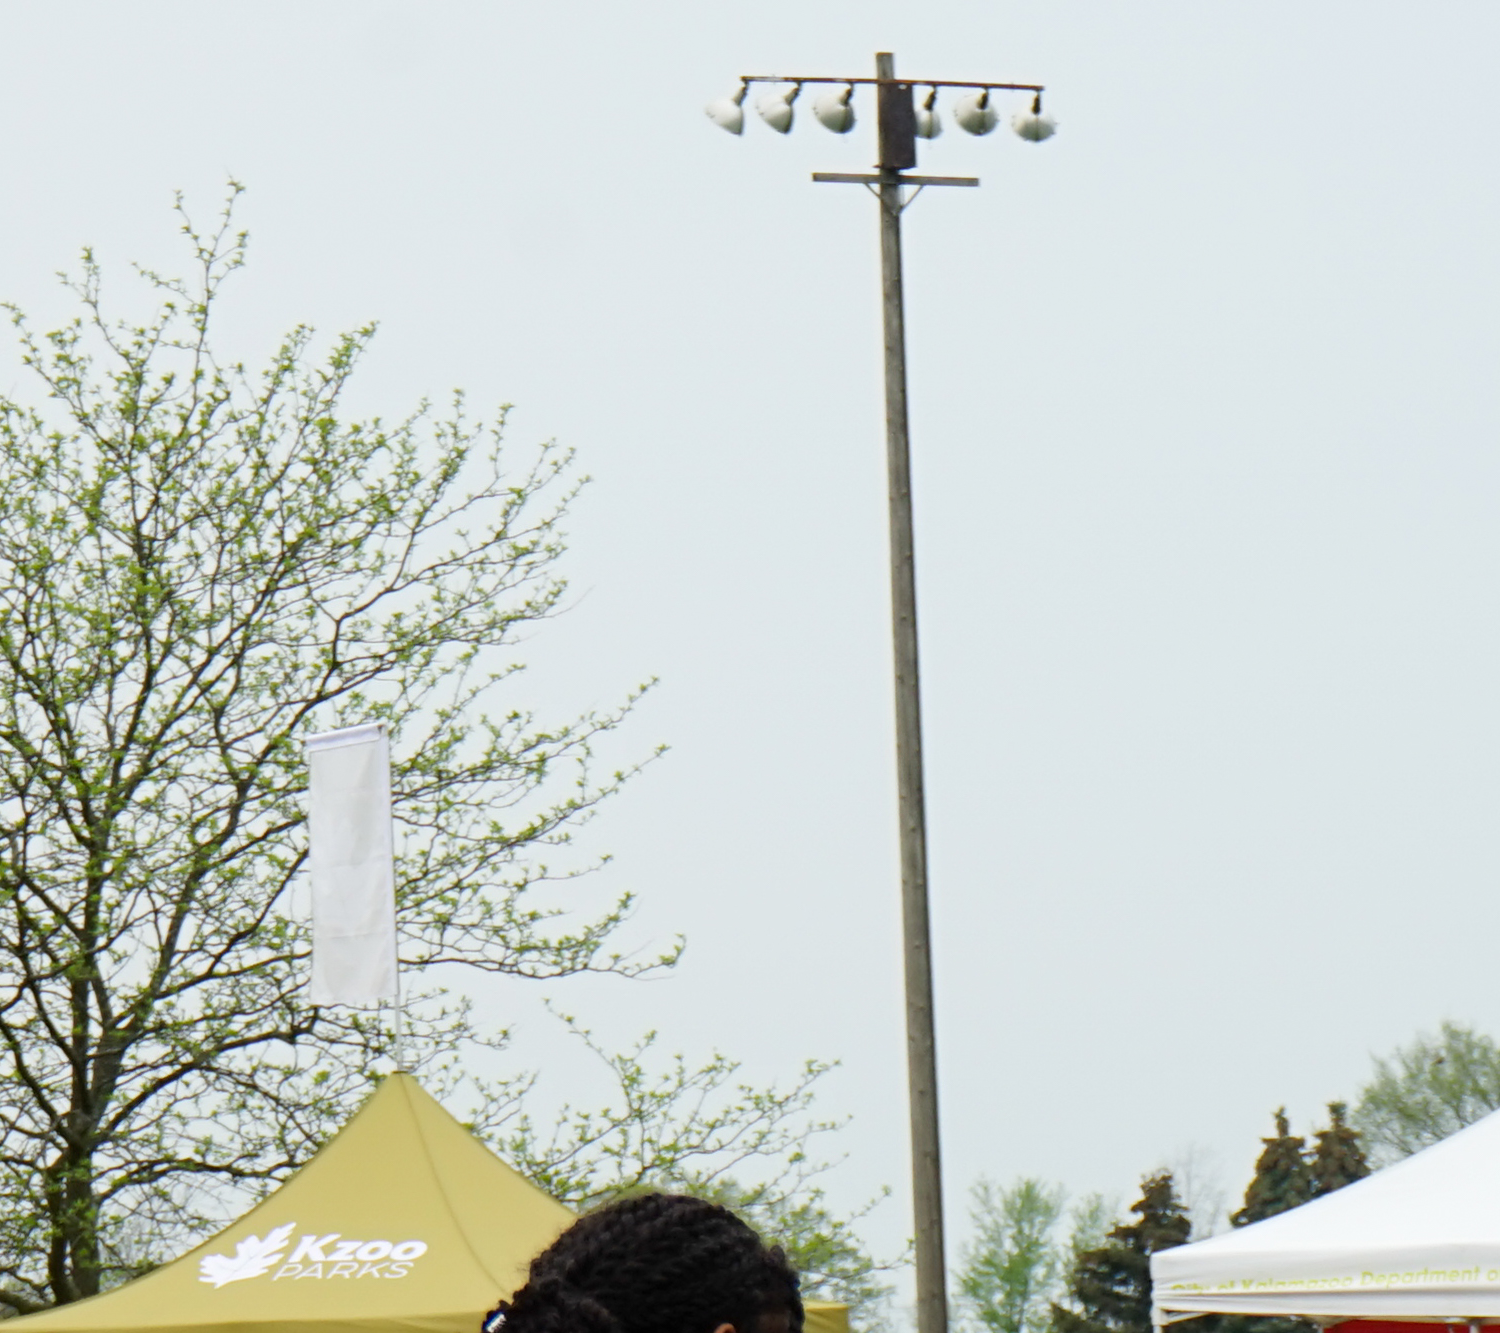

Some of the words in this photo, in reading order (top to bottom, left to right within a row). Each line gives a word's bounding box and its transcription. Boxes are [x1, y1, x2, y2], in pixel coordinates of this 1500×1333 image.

[288, 1233, 428, 1262] Kzoo
[272, 1261, 414, 1281] PARKS
[1360, 1265, 1480, 1289] Department
